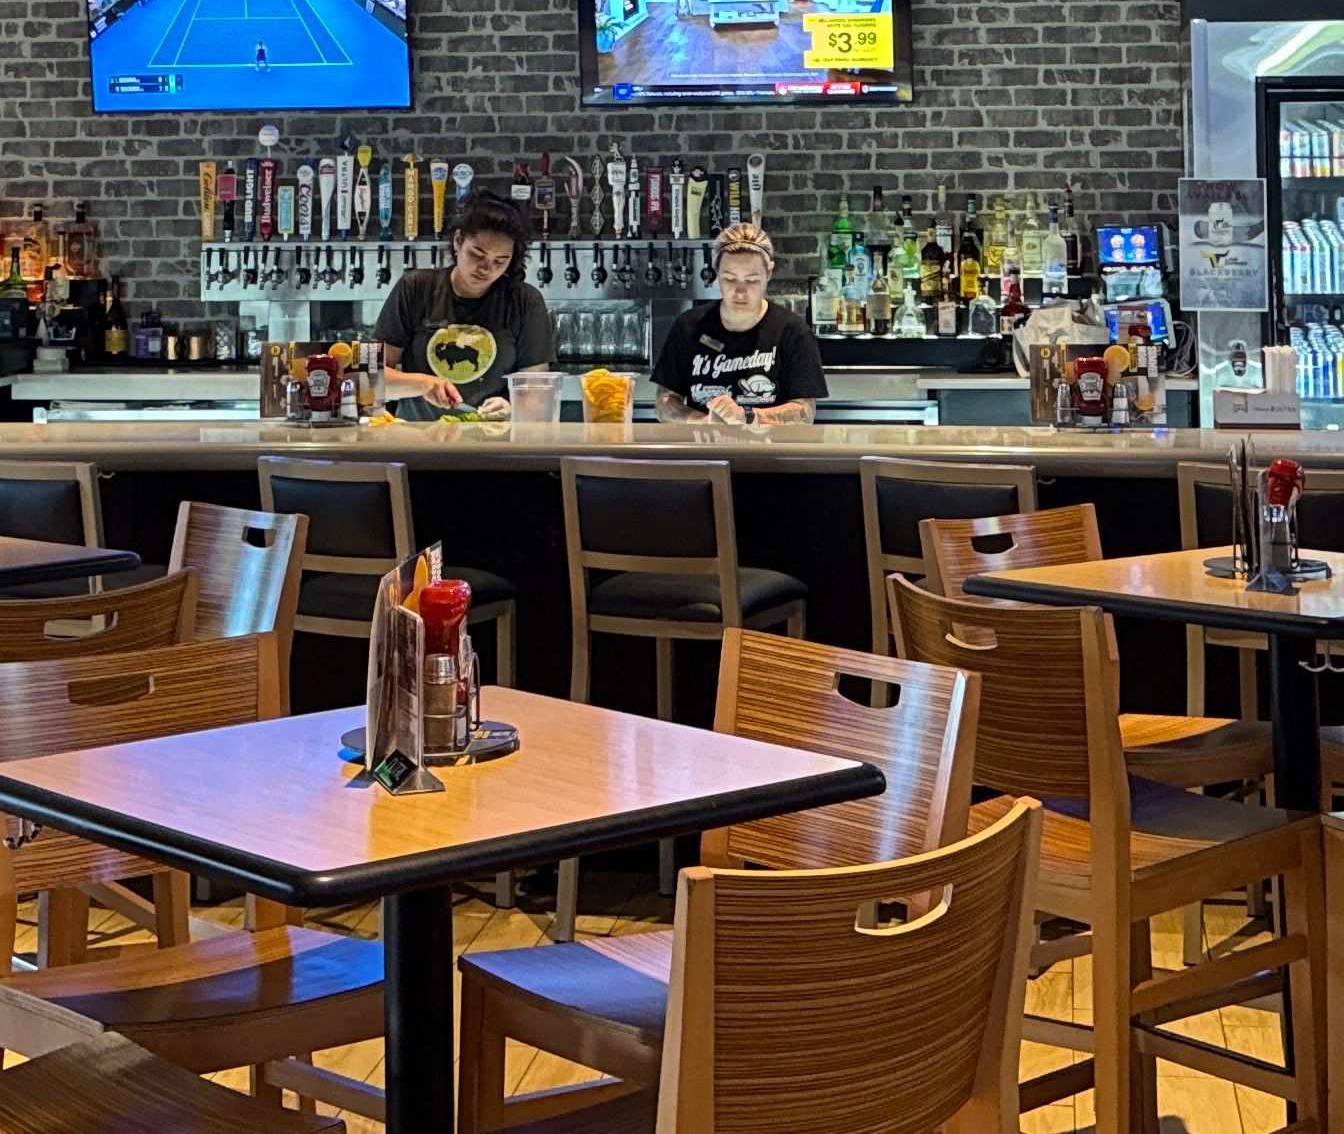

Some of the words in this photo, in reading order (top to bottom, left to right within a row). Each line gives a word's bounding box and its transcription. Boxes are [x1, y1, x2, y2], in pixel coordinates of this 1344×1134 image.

[828, 32, 877, 54] $3.99
[245, 168, 256, 199] LIGHT
[261, 168, 273, 224] Budweiser
[407, 170, 416, 204] MANGO
[729, 181, 740, 206] WILD
[244, 200, 254, 223] BUD
[299, 183, 312, 226] Coors
[692, 354, 711, 376] It's
[712, 346, 776, 378] Gameday!
